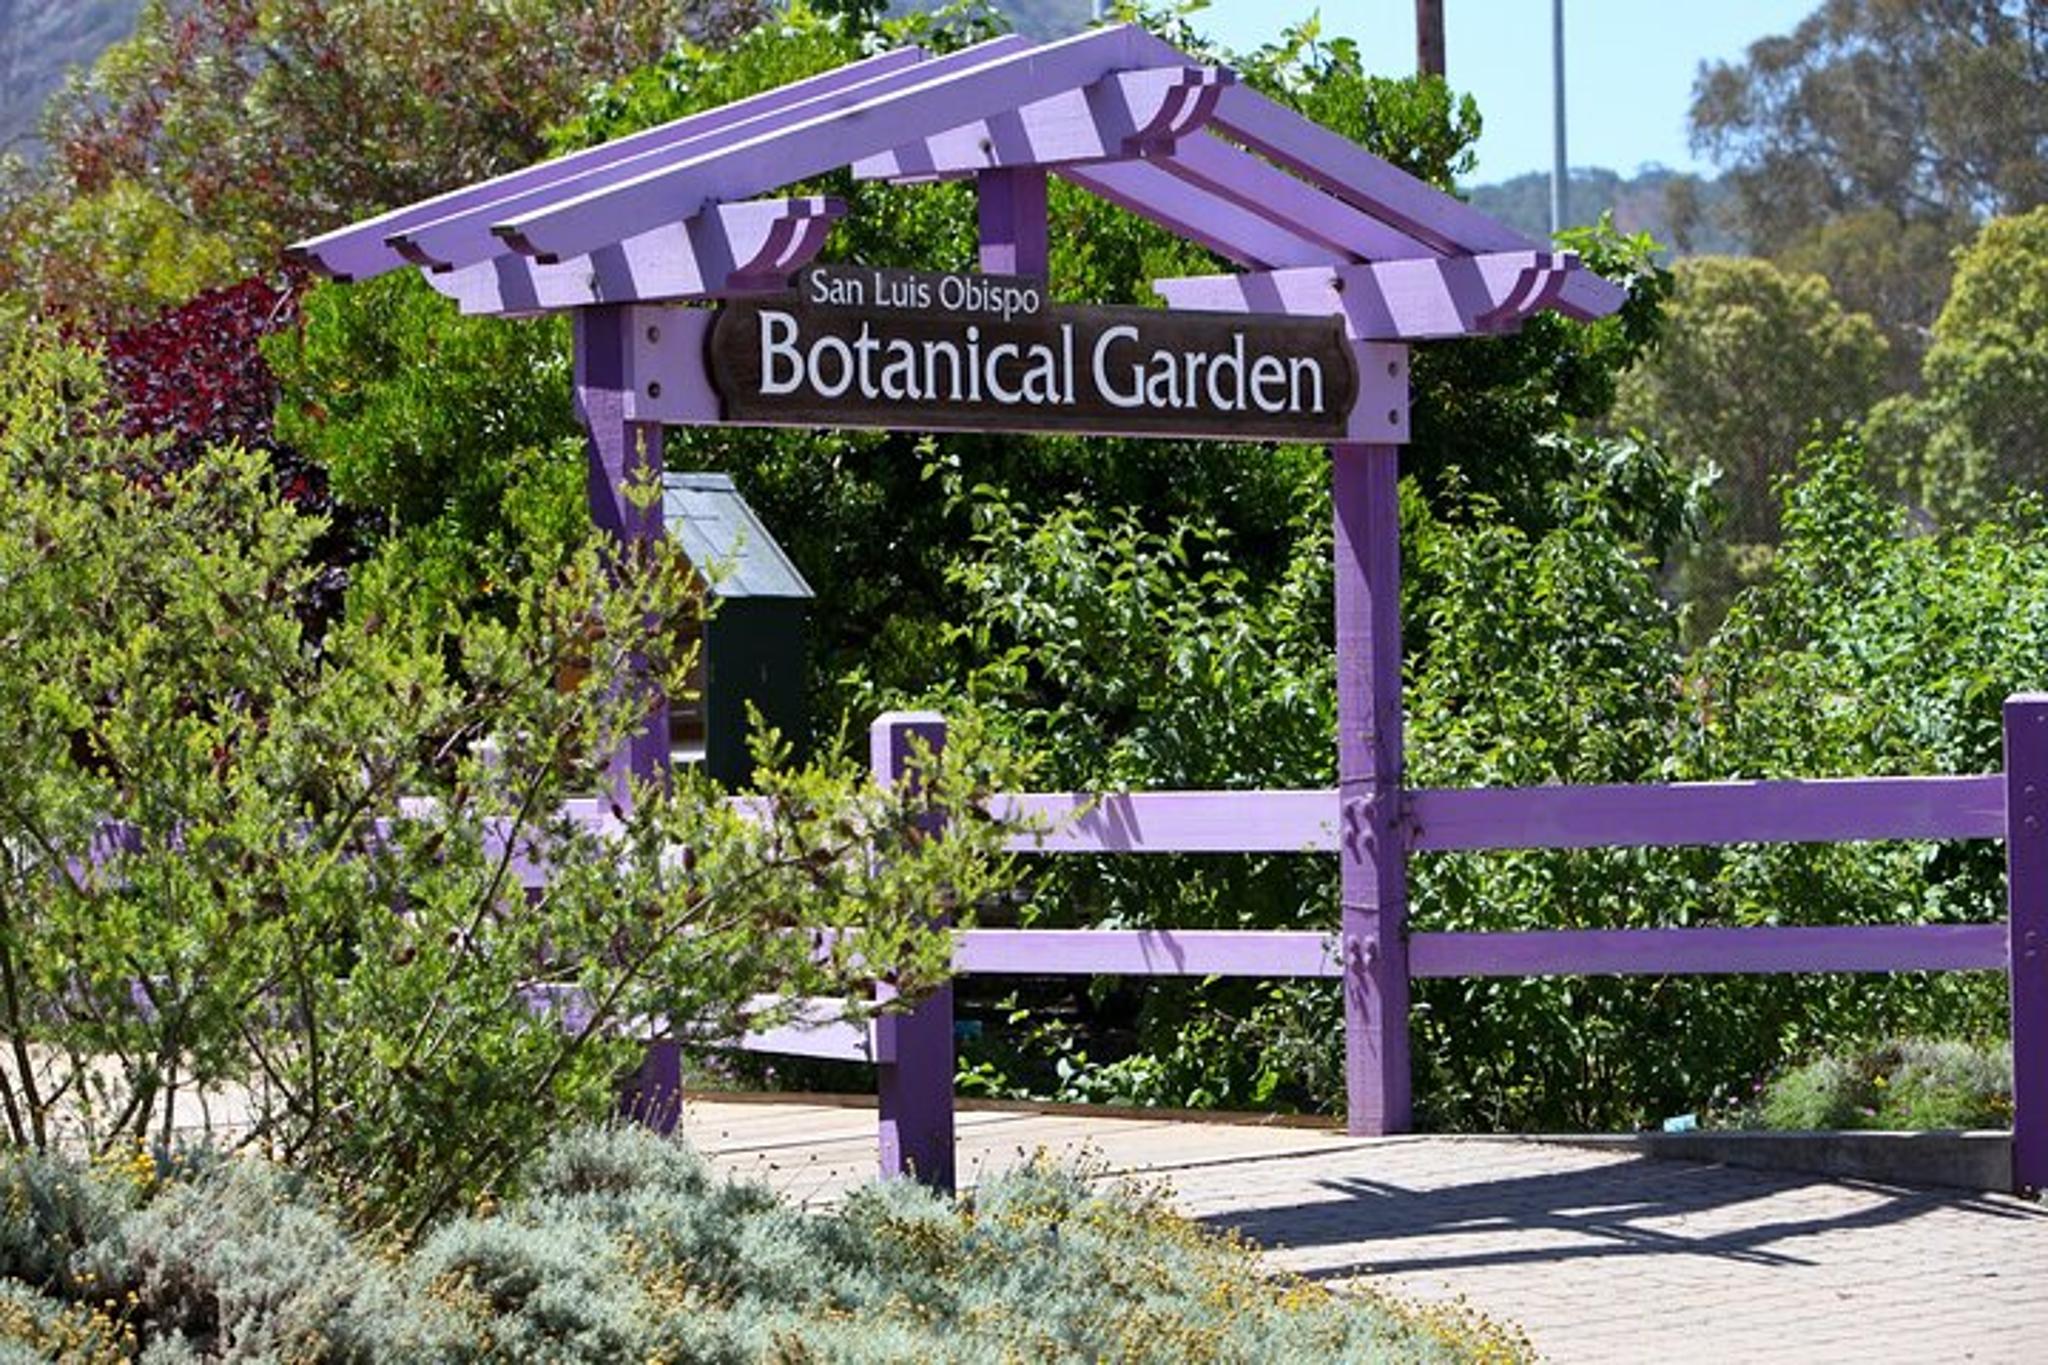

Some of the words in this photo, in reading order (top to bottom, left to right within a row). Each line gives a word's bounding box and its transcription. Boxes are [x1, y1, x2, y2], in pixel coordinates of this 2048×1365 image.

[810, 269, 863, 305] San
[874, 272, 931, 308] Luis
[939, 275, 1040, 321] Obispo
[759, 310, 1074, 404] Botanical
[1093, 325, 1323, 412] Garden
